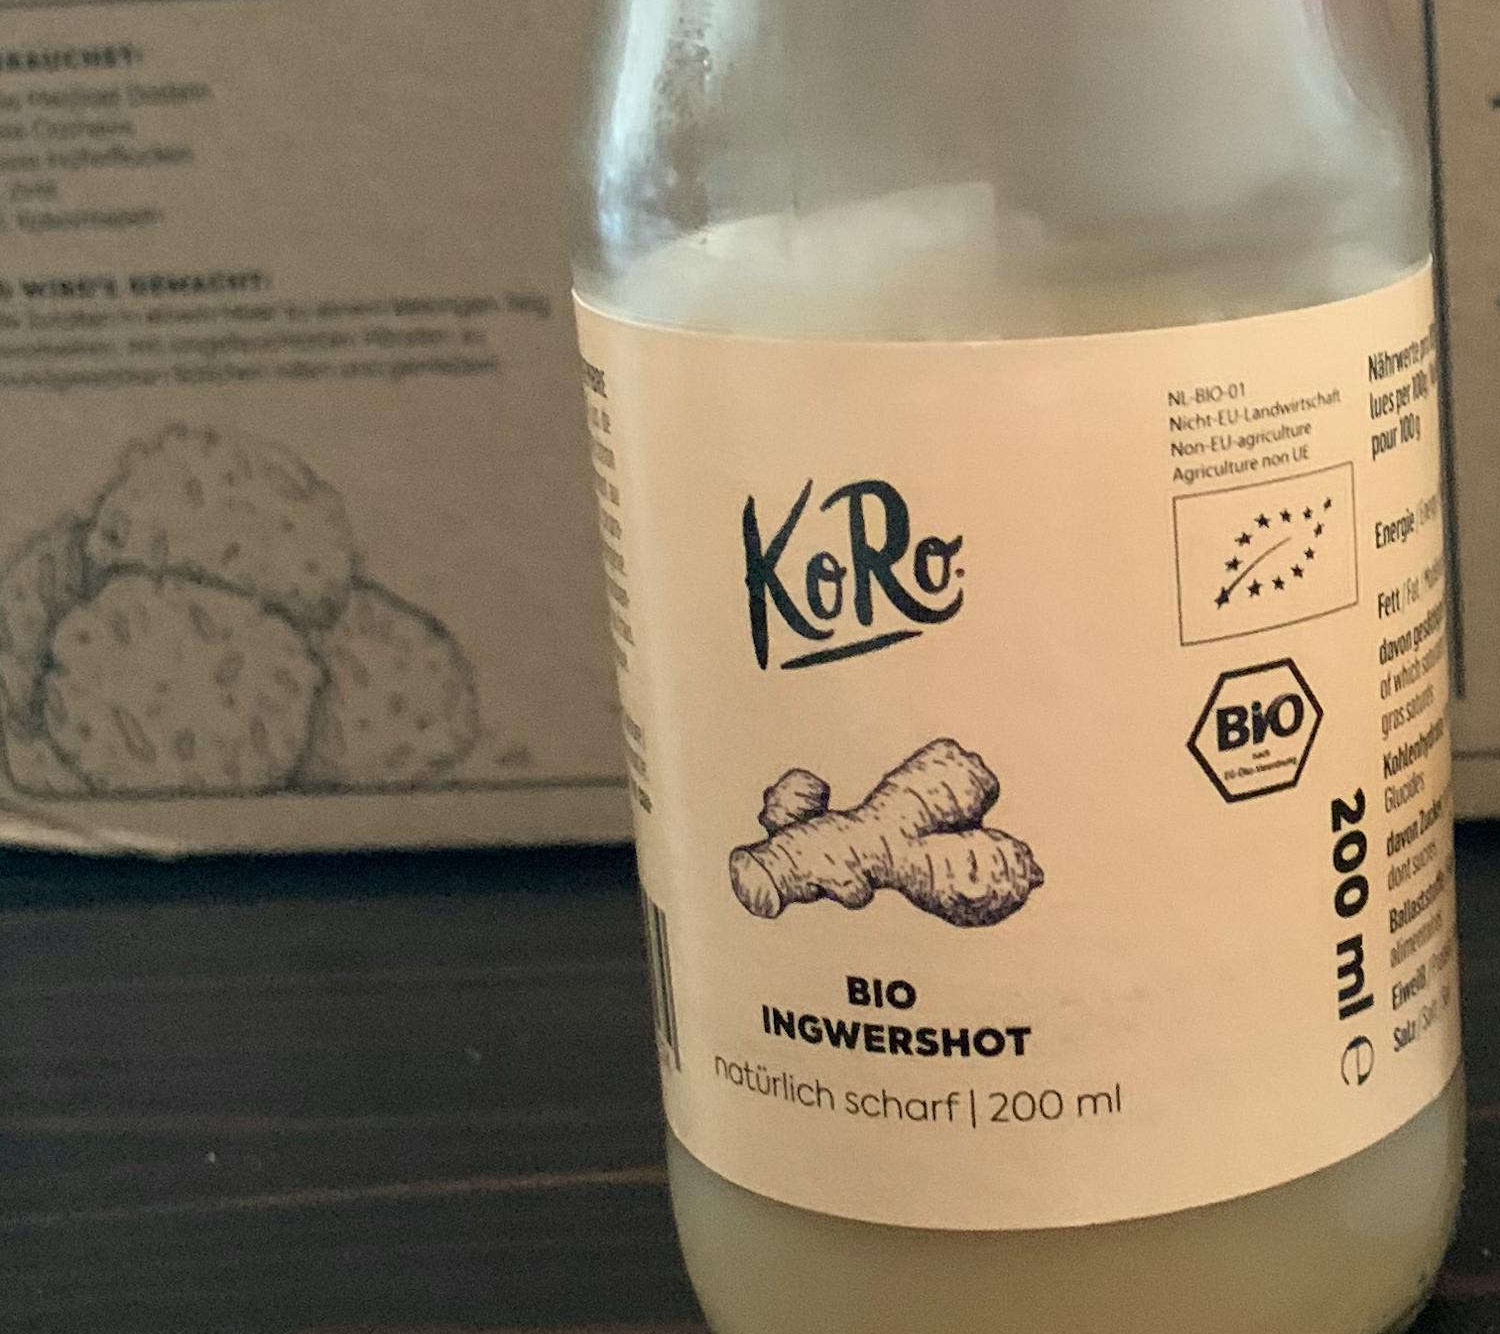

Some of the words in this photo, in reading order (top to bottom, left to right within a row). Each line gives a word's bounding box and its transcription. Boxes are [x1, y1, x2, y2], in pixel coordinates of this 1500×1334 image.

[1167, 380, 1247, 408] NL-BIO-01
[1168, 387, 1342, 433] Nicht-EU-Landwirtschaft
[1170, 421, 1313, 458] Non-EU-agriculture
[1172, 459, 1260, 485] Agriculture
[1261, 452, 1290, 469] non
[1291, 444, 1311, 464] UE
[742, 477, 965, 671] KoRo
[1378, 589, 1401, 620] Fett
[1331, 787, 1370, 920] 200
[845, 974, 918, 1011] BIO
[1336, 934, 1375, 1022] ml
[761, 1005, 1034, 1058] INGWERSHOT
[713, 1052, 836, 1113] natürlich
[845, 1086, 959, 1125] scharf
[989, 1086, 1065, 1124] 200
[1076, 1083, 1122, 1119] ml
